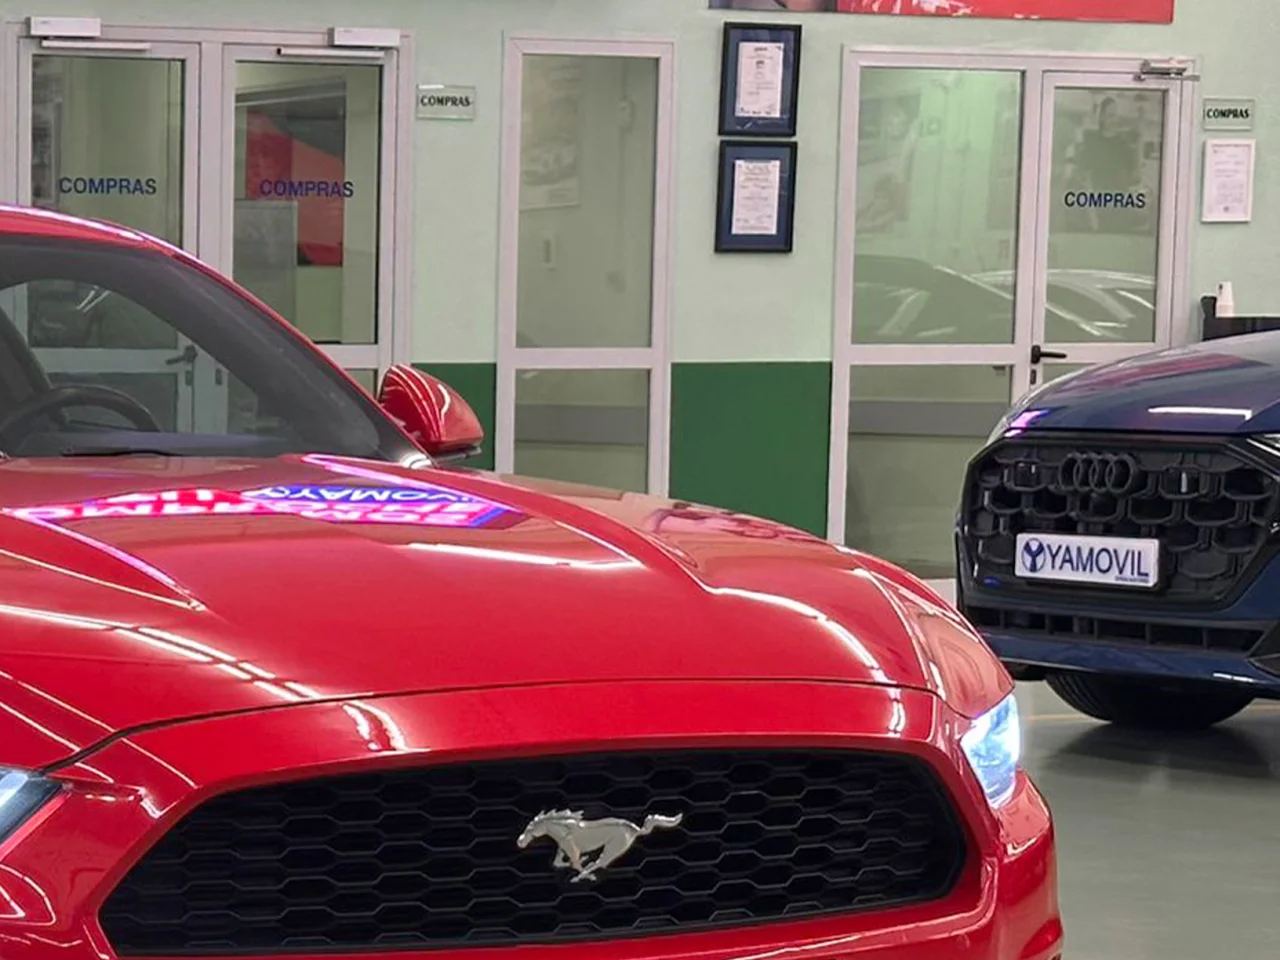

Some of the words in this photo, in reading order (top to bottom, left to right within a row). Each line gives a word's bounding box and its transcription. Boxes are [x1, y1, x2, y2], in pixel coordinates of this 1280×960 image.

[420, 94, 471, 107] COMPRAS
[1206, 107, 1250, 119] COMPRAS
[59, 176, 157, 196] COMPRAS
[260, 178, 354, 198] COMPRAS
[1064, 191, 1146, 209] COMPRAS
[1047, 543, 1149, 577] YAMOVIL
